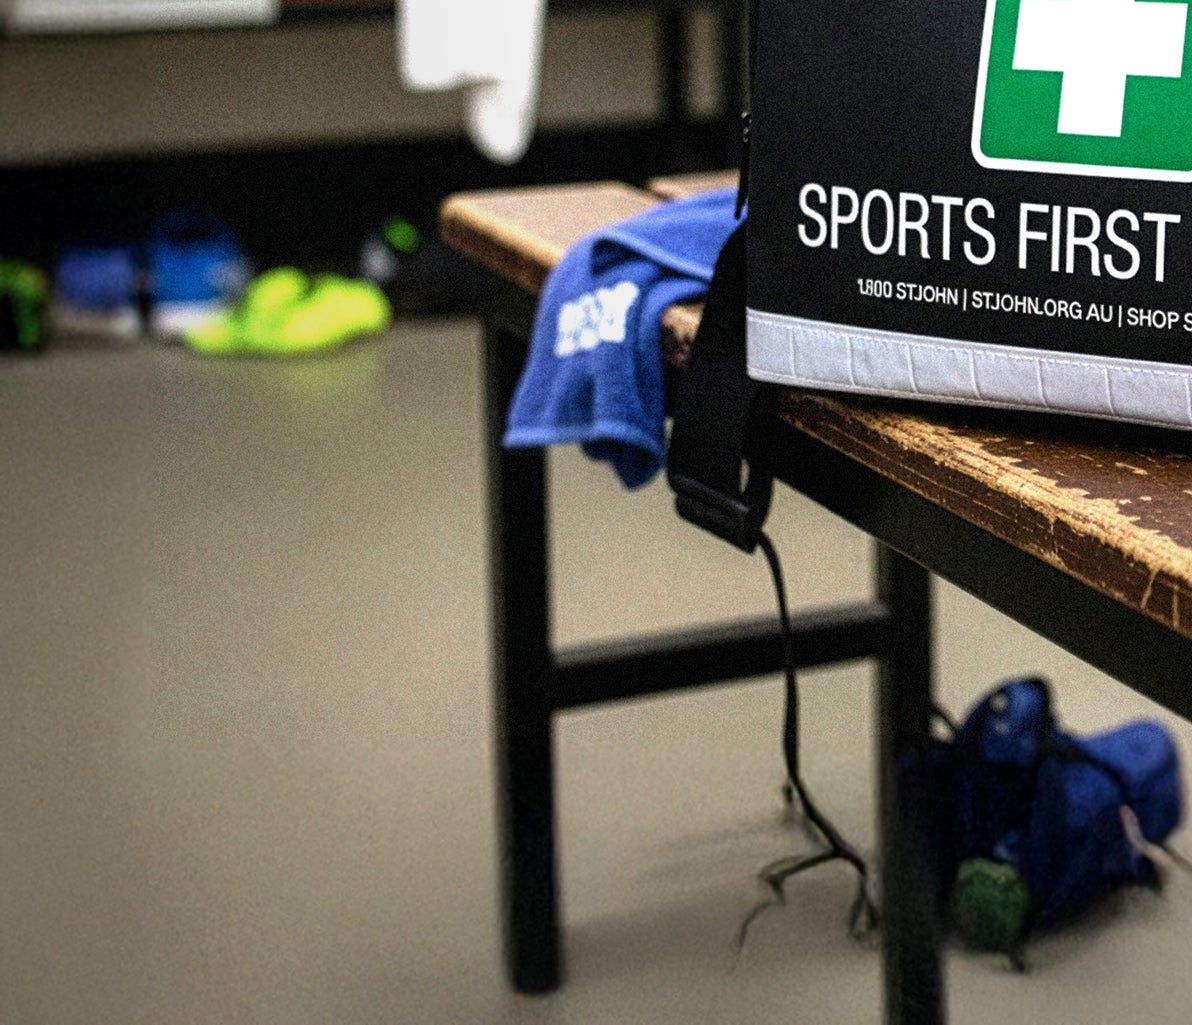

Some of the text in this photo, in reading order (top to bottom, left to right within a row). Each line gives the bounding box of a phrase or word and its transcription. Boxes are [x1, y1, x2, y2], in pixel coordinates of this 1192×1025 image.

[797, 182, 996, 266] SPORTS
[1018, 202, 1182, 283] FIRST
[895, 281, 959, 306] STJOHN
[1085, 303, 1113, 323] AU
[1126, 307, 1180, 330] SHOP
